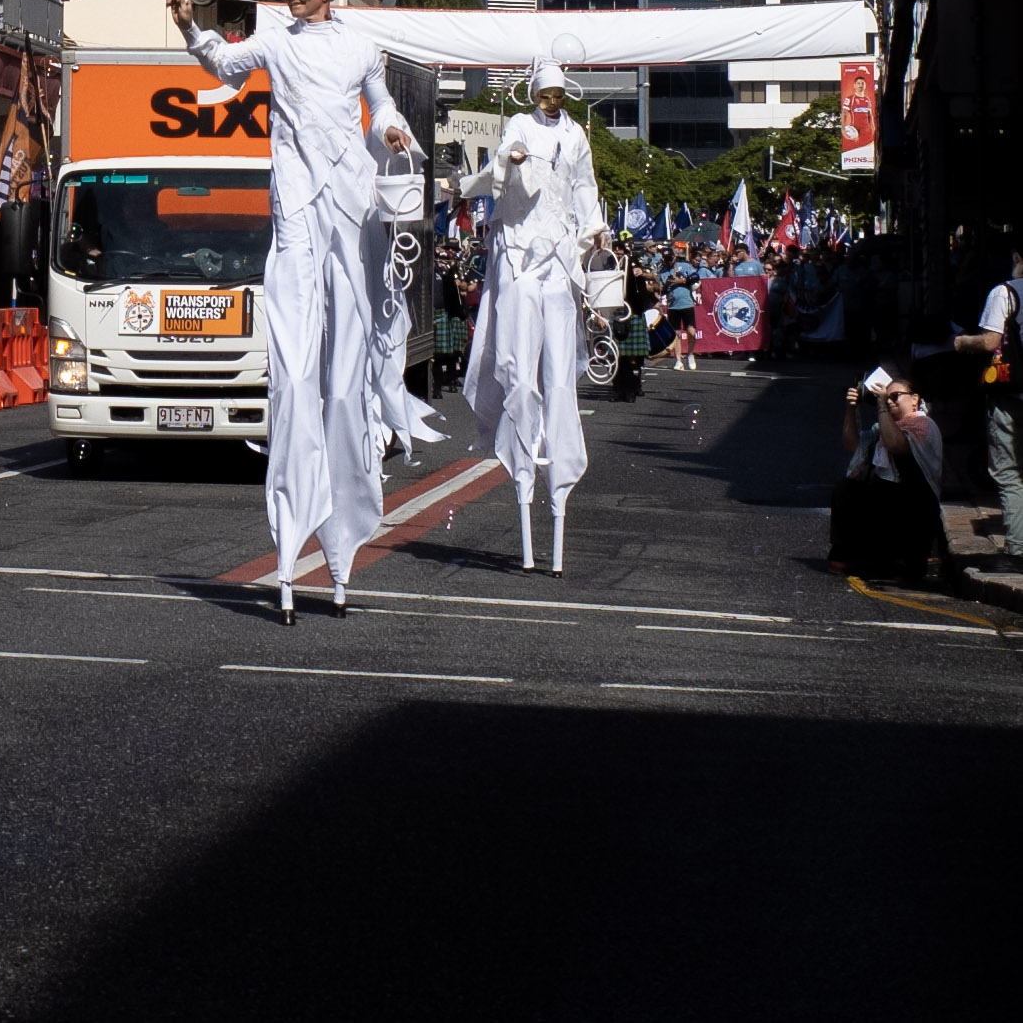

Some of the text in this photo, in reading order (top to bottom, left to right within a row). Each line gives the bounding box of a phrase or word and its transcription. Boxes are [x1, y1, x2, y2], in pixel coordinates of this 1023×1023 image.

[89, 300, 114, 308] NNR
[166, 295, 233, 308] TRANSPORT
[165, 307, 225, 319] WORKERS'
[165, 319, 201, 331] UNION
